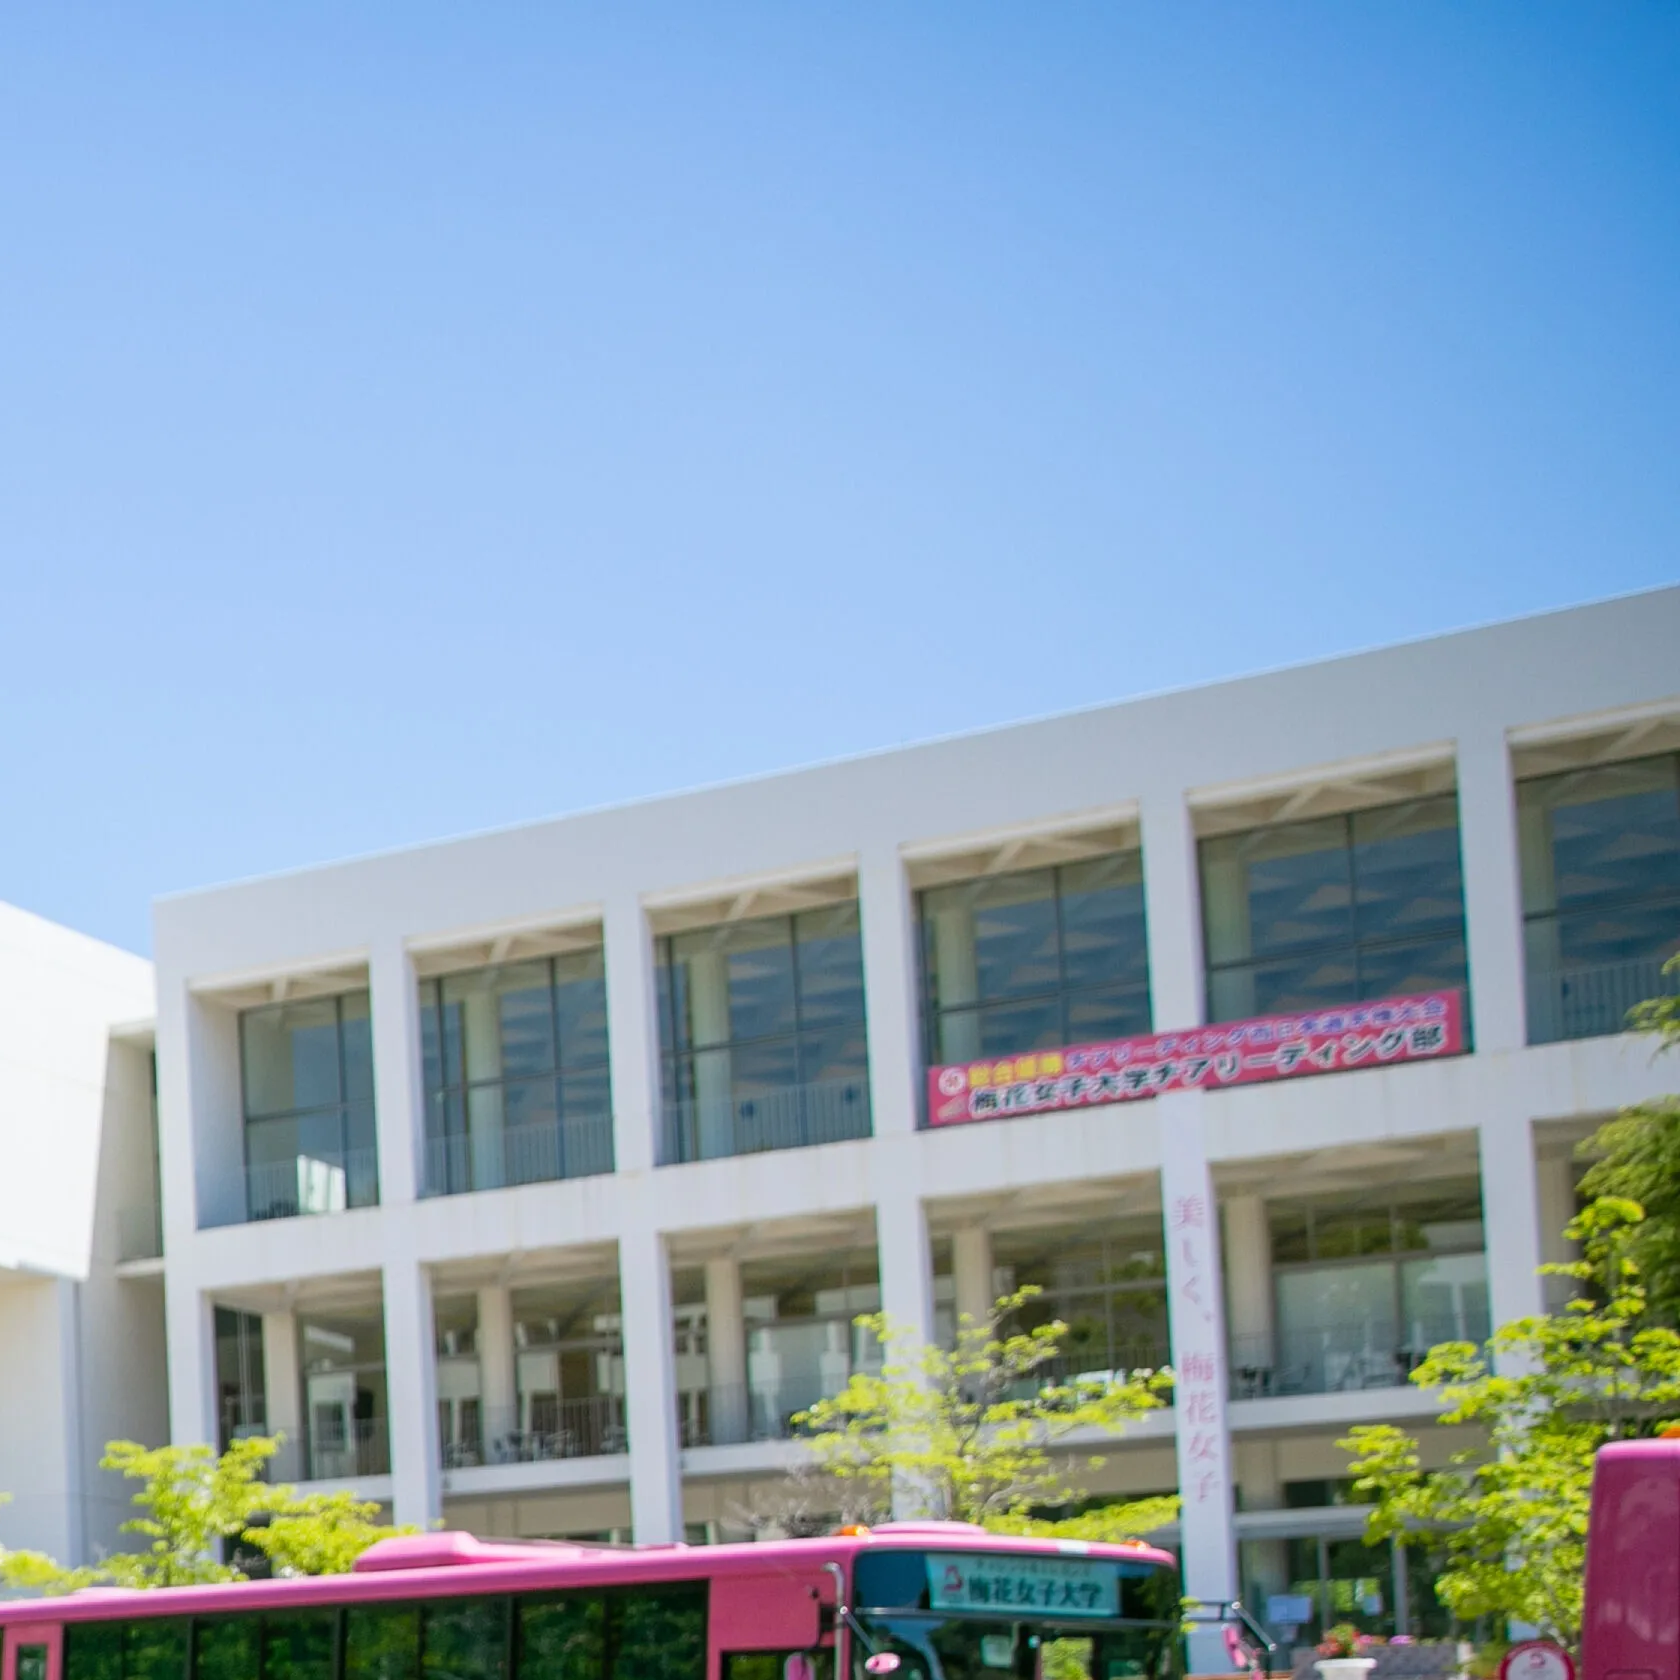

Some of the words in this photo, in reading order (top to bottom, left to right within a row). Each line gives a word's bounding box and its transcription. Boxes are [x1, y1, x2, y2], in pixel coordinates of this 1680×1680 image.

[969, 1022, 1447, 1119] 梅花女子大学チアリーディング部
[968, 1573, 1104, 1610] 梅花女子大学
